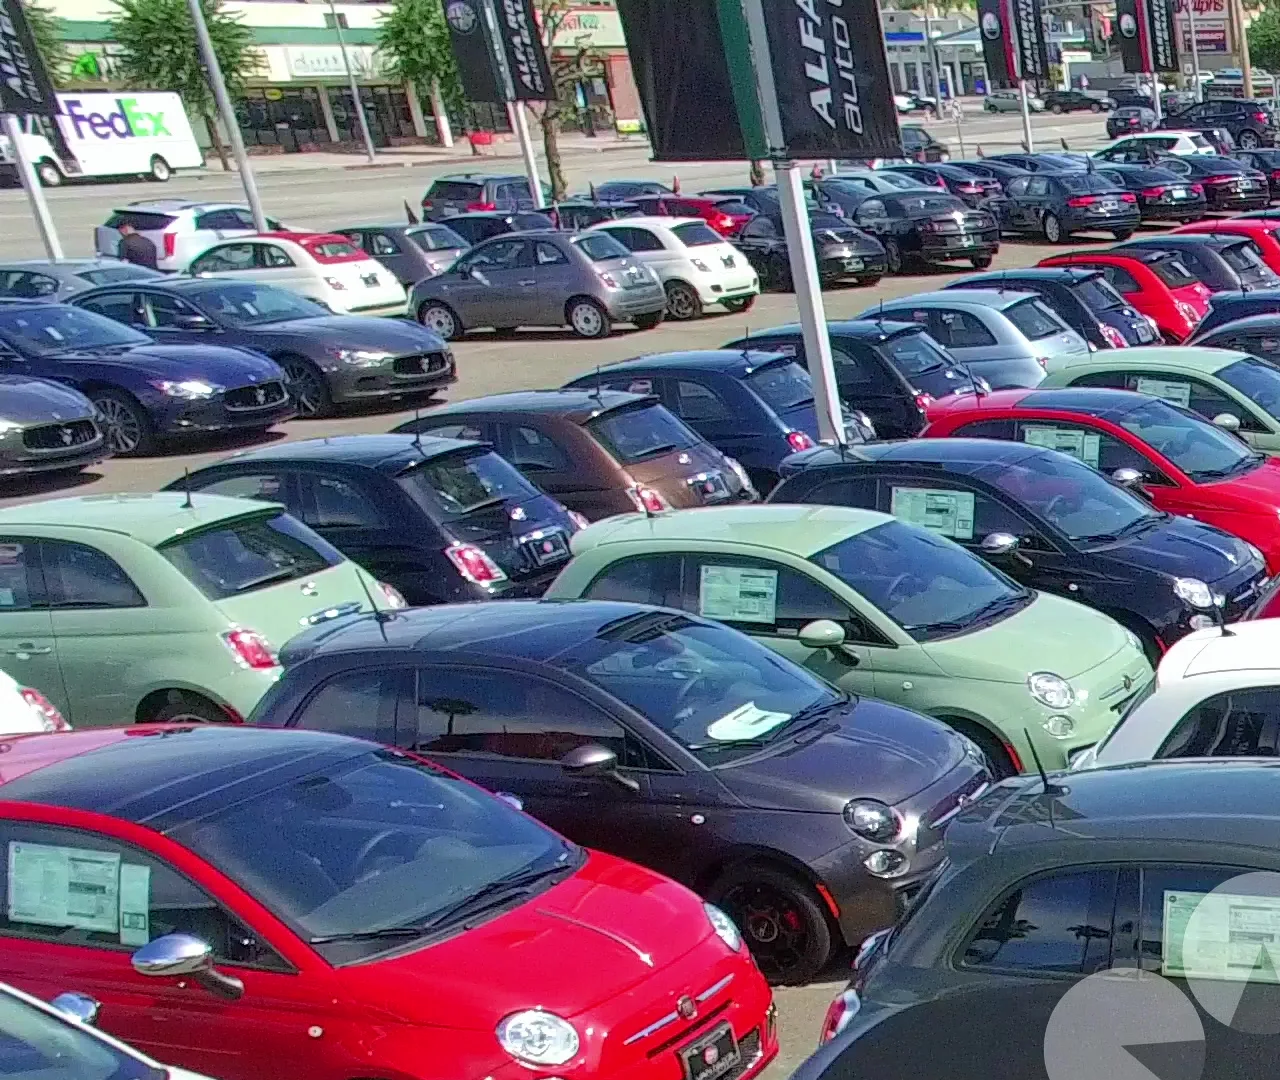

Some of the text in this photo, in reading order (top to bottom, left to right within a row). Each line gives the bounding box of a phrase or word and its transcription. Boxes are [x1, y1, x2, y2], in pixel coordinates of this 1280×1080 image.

[511, 37, 534, 90] ALFA
[832, 15, 863, 135] auto
[63, 98, 173, 140] FedEx
